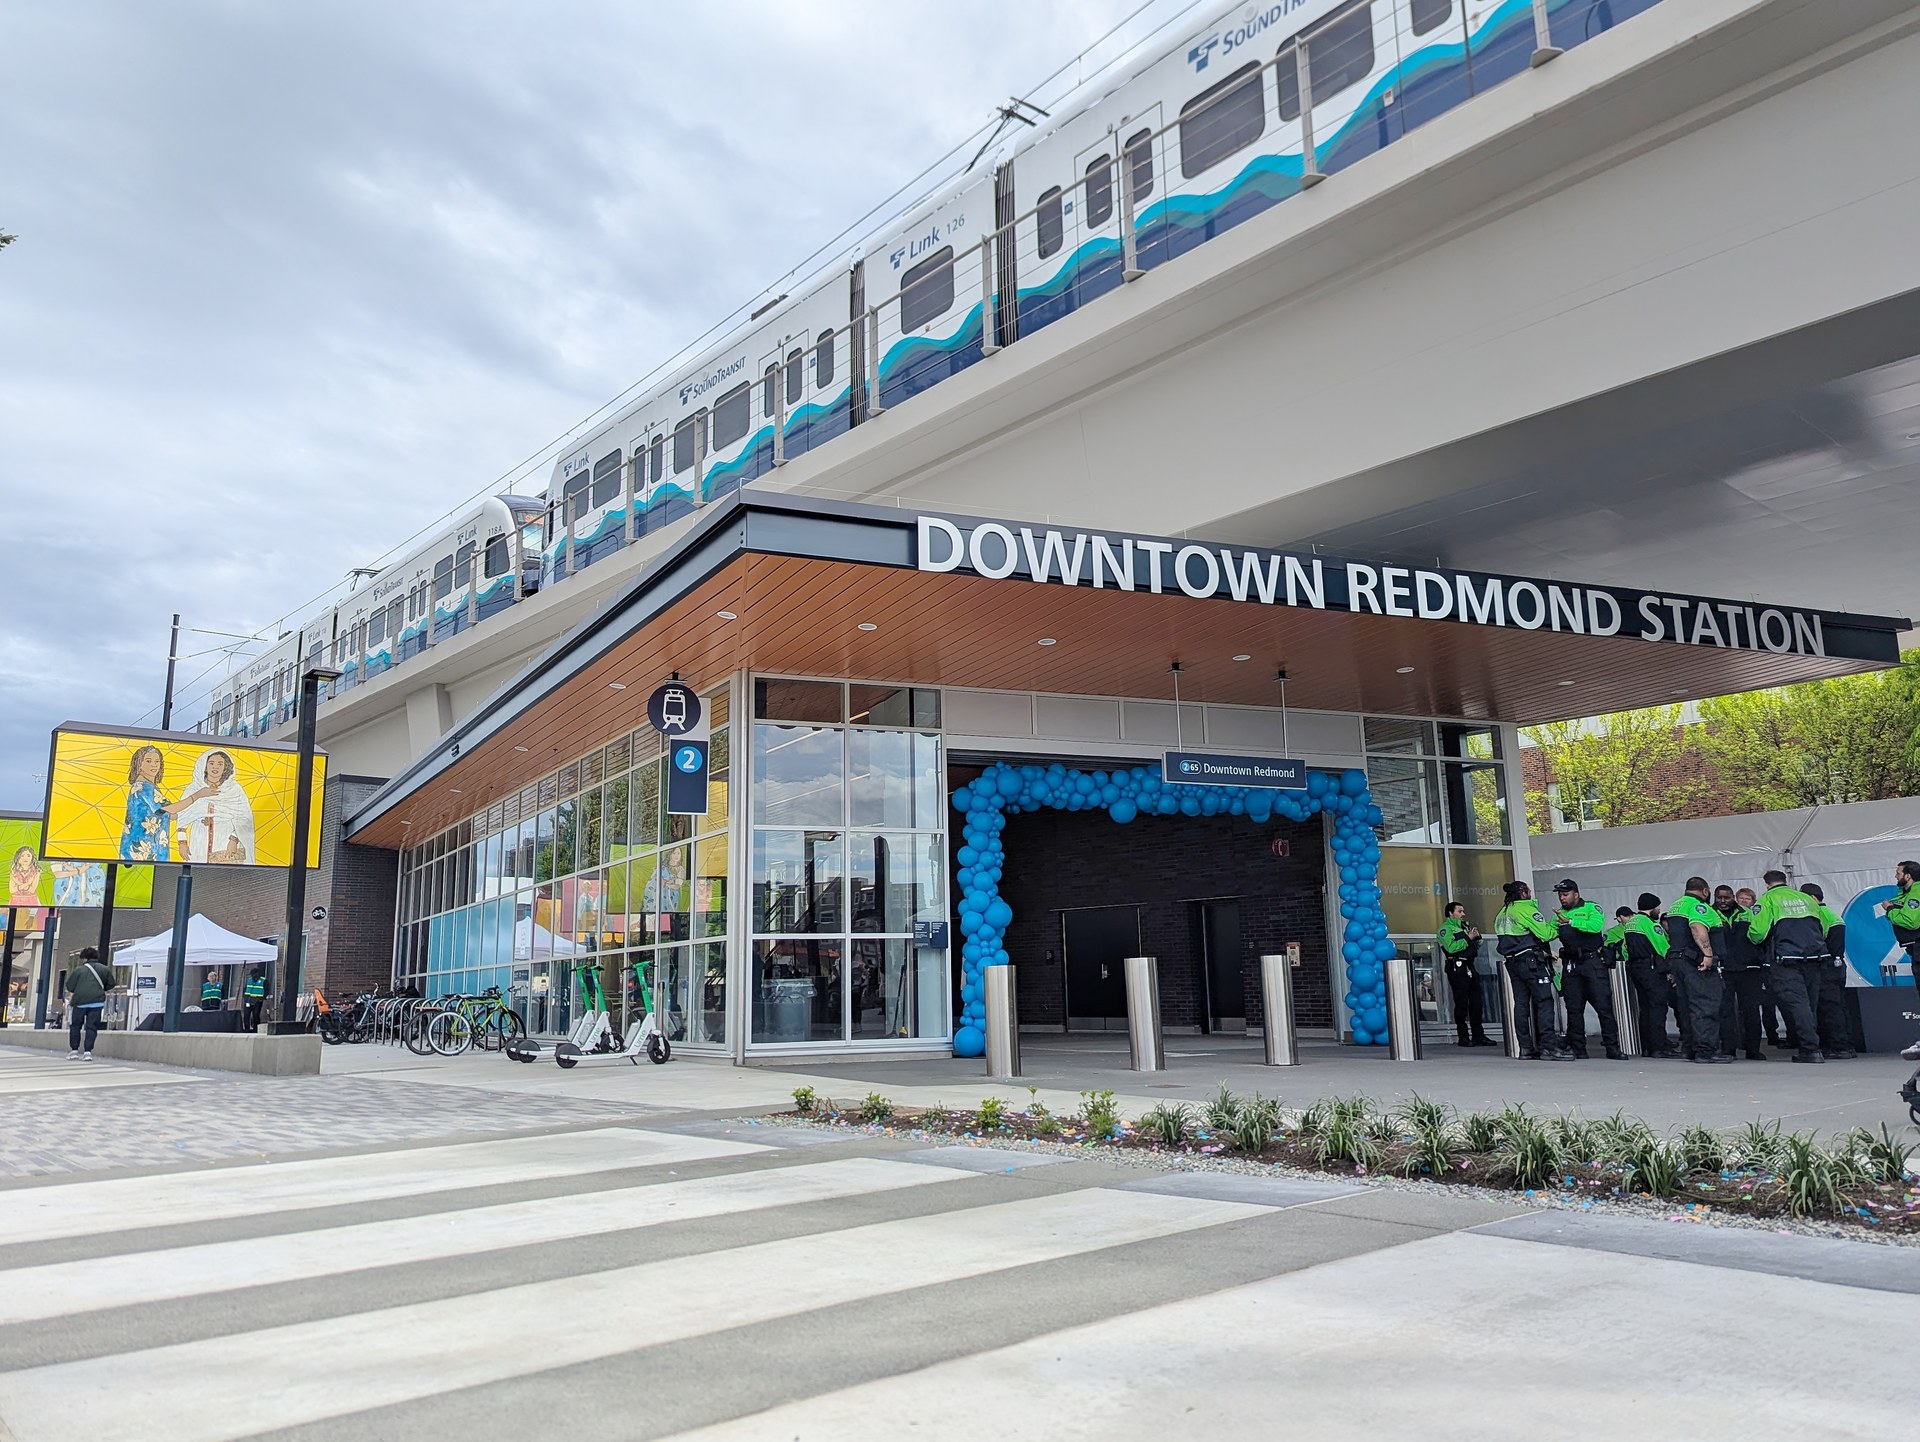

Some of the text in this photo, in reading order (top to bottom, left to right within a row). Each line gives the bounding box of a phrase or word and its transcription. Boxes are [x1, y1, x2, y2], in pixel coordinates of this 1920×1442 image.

[910, 213, 965, 259] Link 126
[917, 515, 1826, 657] DOWNTOWN REDMOND STATION
[683, 750, 695, 769] 2
[1190, 763, 1199, 772] 65
[1203, 763, 1252, 776] Downtown
[1254, 766, 1295, 778] Redmond
[1384, 882, 1430, 895] welcome
[1453, 884, 1500, 896] redmond!
